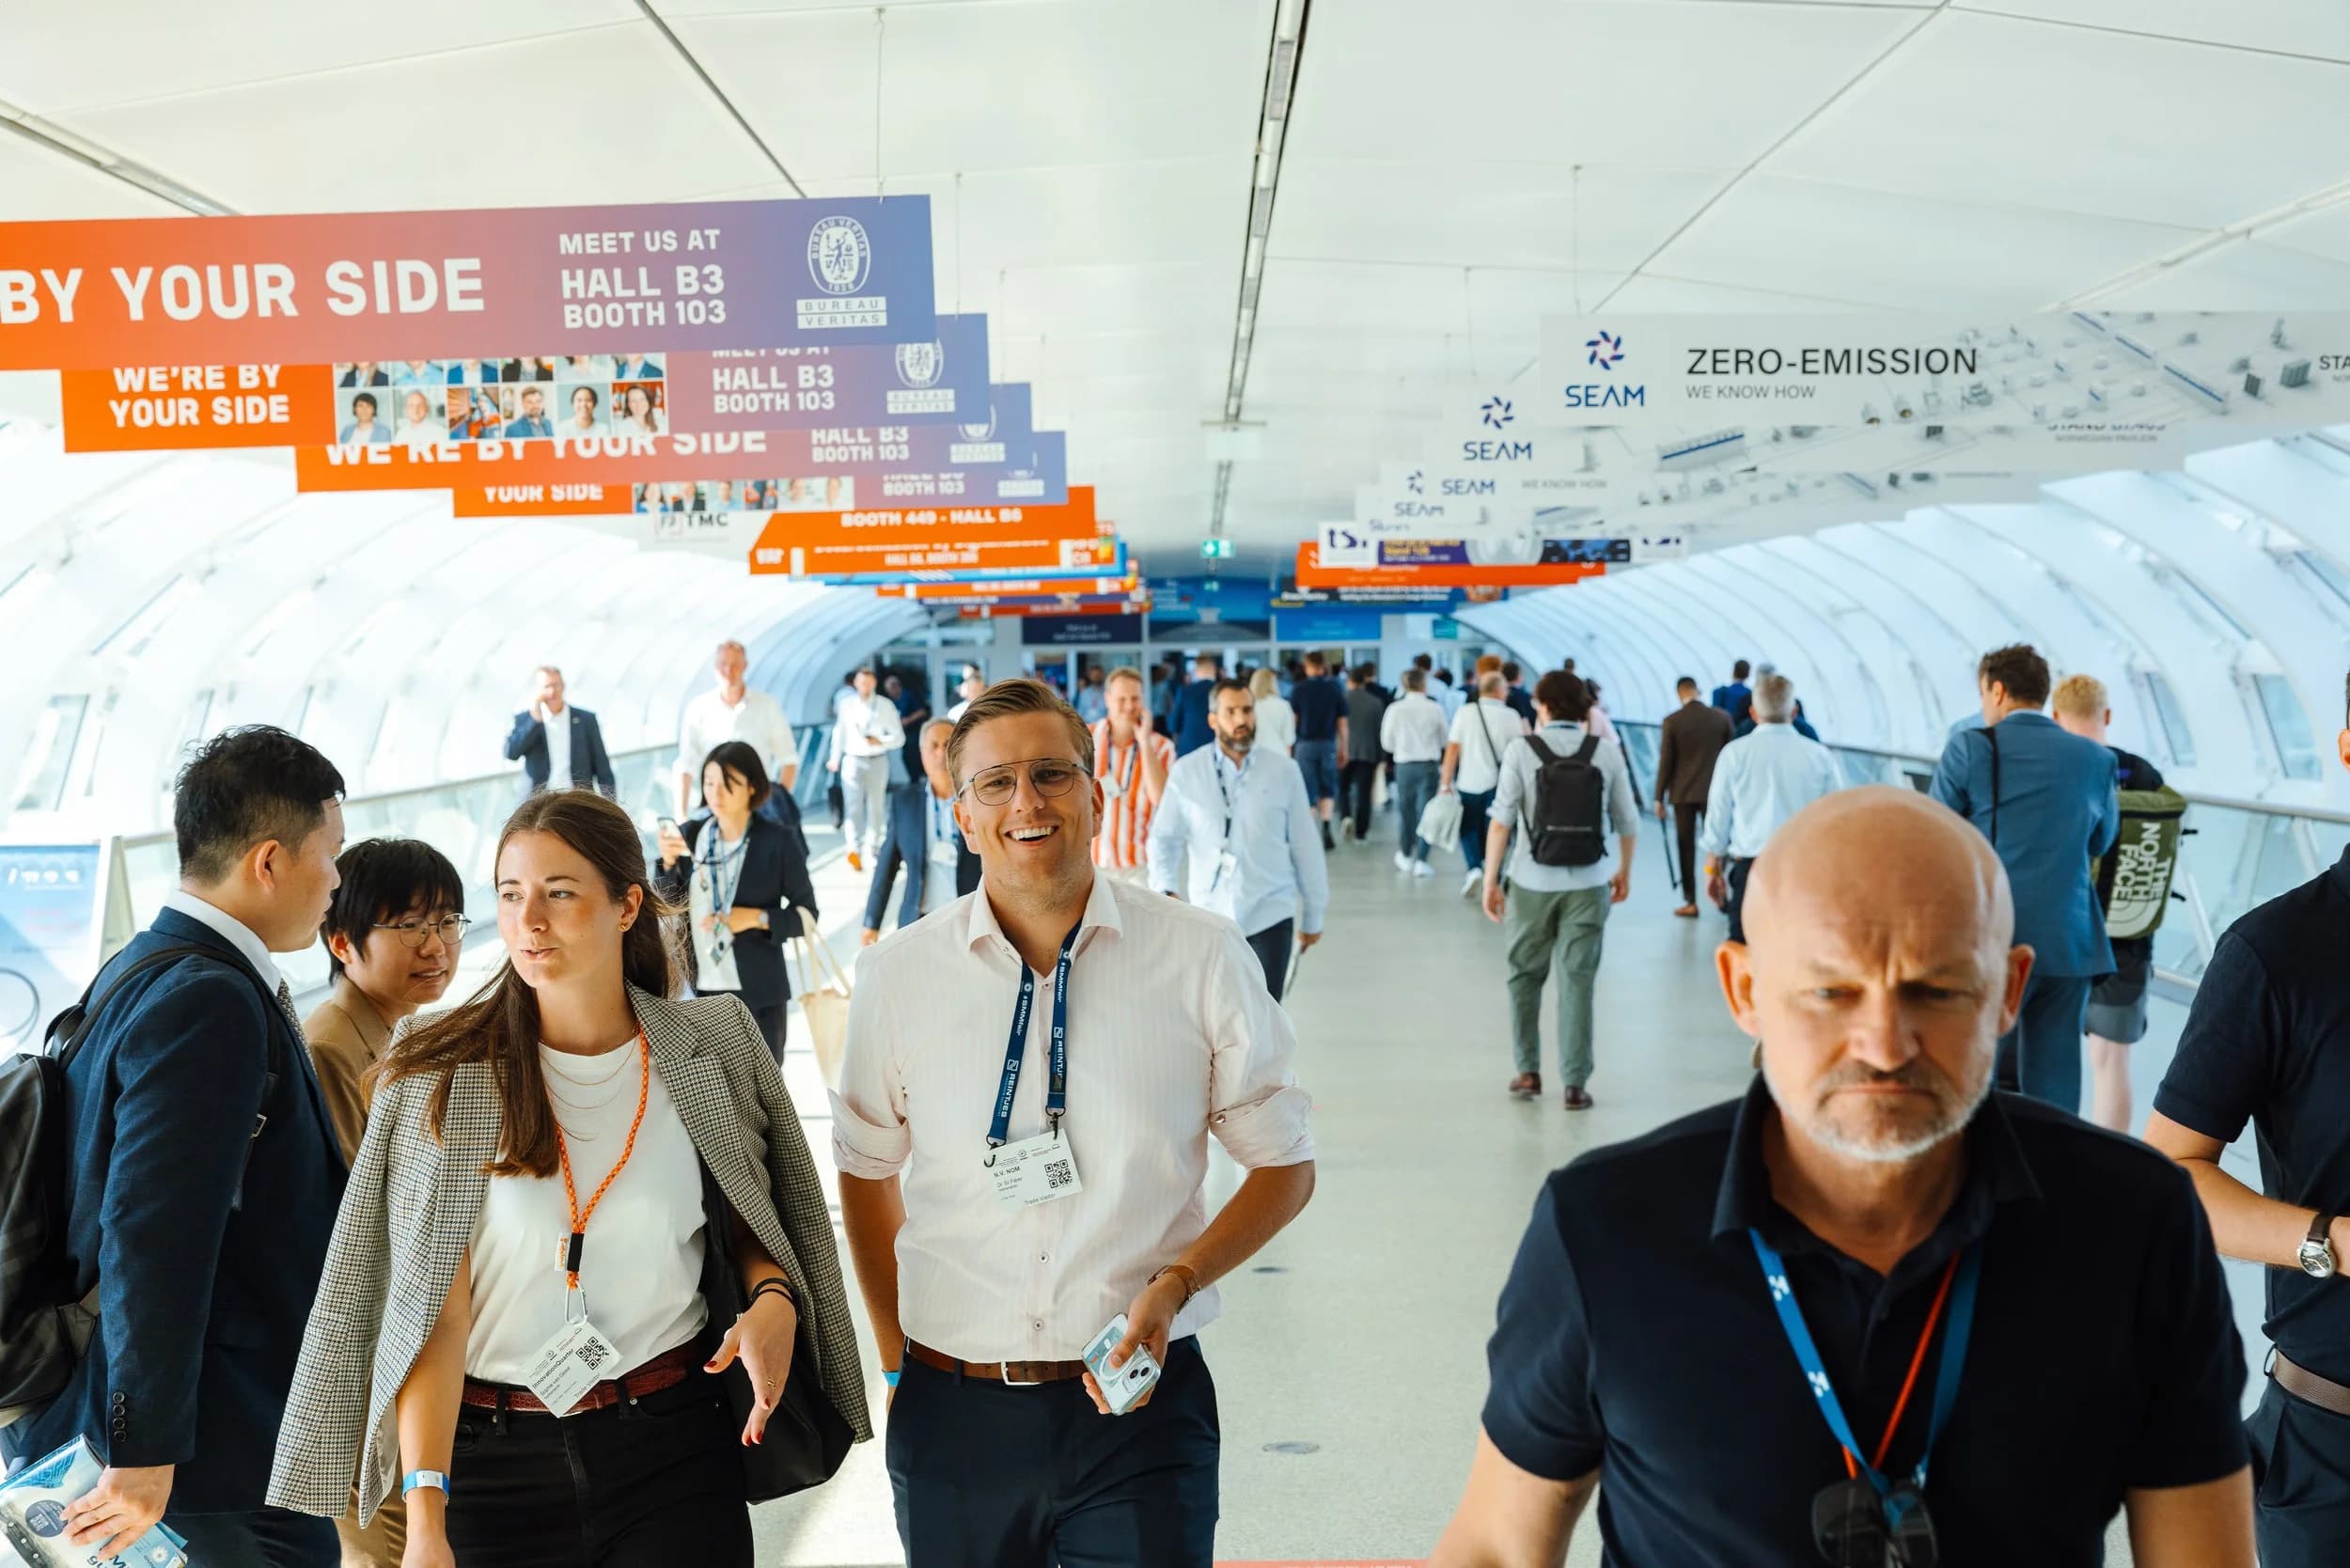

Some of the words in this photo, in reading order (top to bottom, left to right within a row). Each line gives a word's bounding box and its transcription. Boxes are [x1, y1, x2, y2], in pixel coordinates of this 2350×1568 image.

[559, 231, 634, 255] MEET
[644, 230, 678, 252] US
[687, 228, 721, 251] AT
[0, 268, 83, 324] BY
[111, 263, 299, 321] YOUR
[325, 258, 485, 316] SIDE
[561, 267, 662, 299] HALL
[676, 264, 725, 295] B3
[564, 301, 666, 329] BOOTH
[675, 299, 726, 325] 103
[805, 300, 879, 311] BUREAU
[806, 314, 880, 325] VERITAS
[1687, 349, 1978, 375] ZERO-EMISSION
[113, 365, 227, 393] WE'RE
[238, 364, 281, 389] BY
[713, 366, 788, 391] HALL
[797, 364, 835, 388] B3
[714, 392, 790, 414] BOOTH
[797, 391, 835, 411] 103
[1565, 385, 1645, 407] SEAM
[1685, 385, 1712, 399] WE
[1717, 385, 1771, 399] KNOW
[1775, 385, 1816, 399] HOW
[108, 397, 200, 429] YOUR
[212, 394, 290, 426] SIDE
[811, 429, 871, 445] HALL
[812, 445, 873, 463] BOOTH
[879, 444, 910, 462] 103
[1464, 441, 1532, 462] SEAM
[551, 483, 603, 502] SIDE
[1441, 479, 1496, 495] SEAM
[687, 513, 728, 526] TMC
[840, 511, 901, 527] BOOTH
[949, 509, 996, 525] HALL
[2112, 844, 2140, 901] FACE
[2131, 821, 2162, 902] NORTH
[2151, 856, 2172, 902] THE
[532, 1348, 574, 1388] InnovationQuarter
